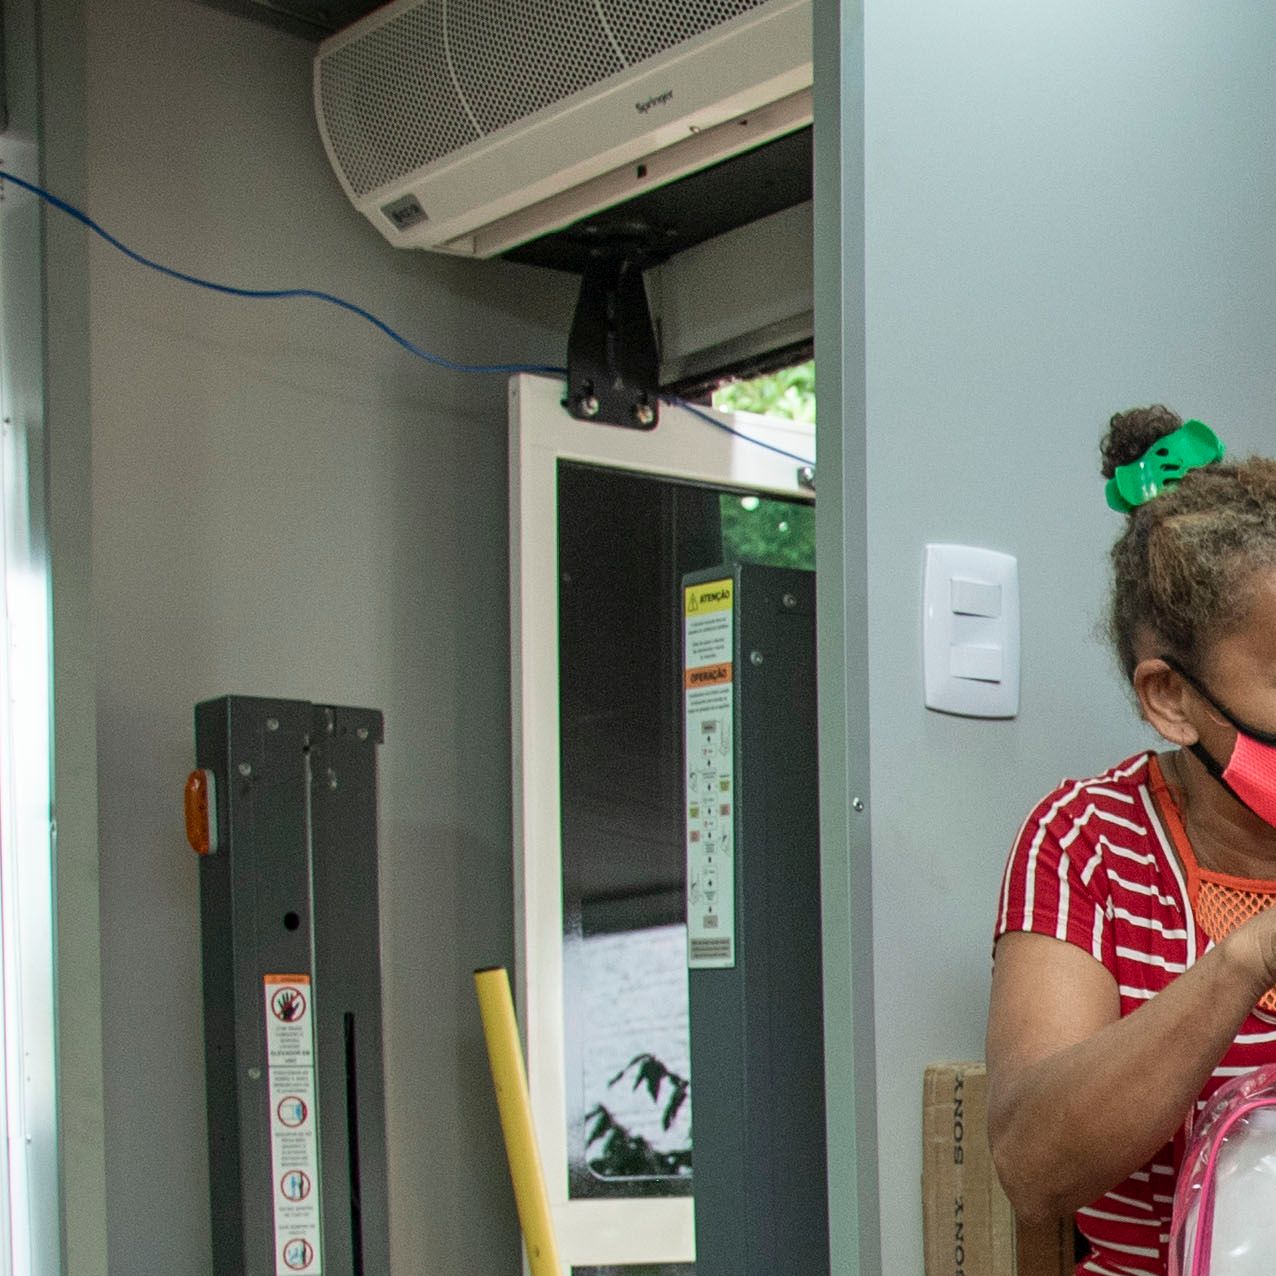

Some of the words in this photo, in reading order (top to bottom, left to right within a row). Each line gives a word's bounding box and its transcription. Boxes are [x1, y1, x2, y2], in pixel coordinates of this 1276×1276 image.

[700, 589, 730, 603] ATENÇÃO
[690, 668, 727, 683] OPERAÇÃO
[953, 1070, 965, 1165] SONY
